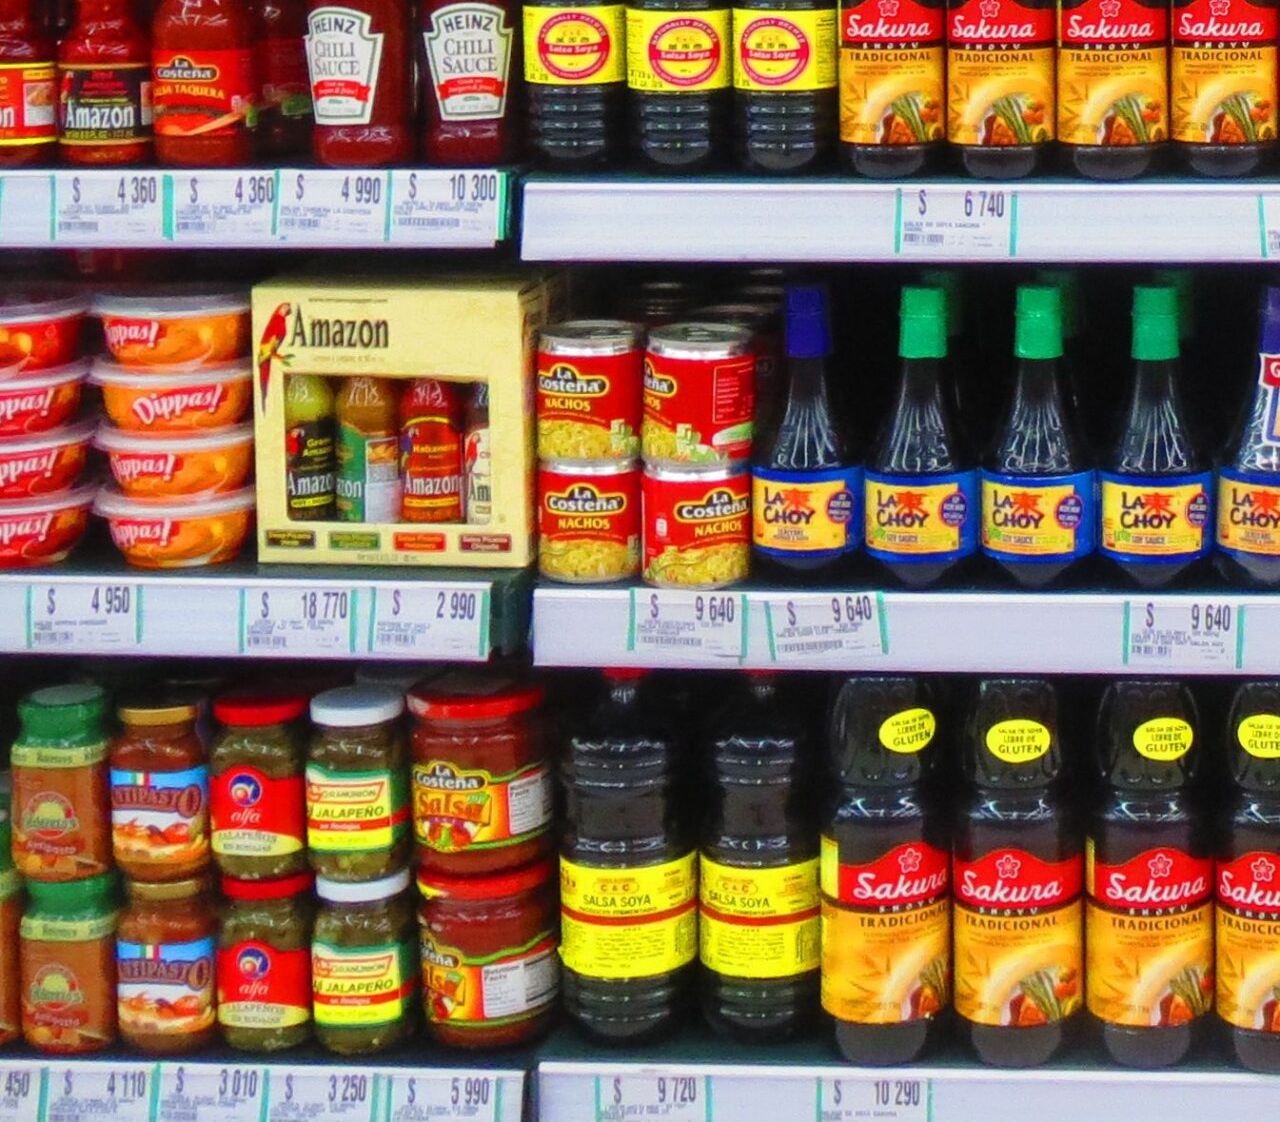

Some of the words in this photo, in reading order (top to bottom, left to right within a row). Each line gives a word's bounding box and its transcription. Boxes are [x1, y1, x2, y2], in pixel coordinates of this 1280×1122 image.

[313, 17, 356, 35] HEINZ
[443, 15, 494, 34] HEINZ
[847, 15, 933, 39] Sakura
[952, 16, 1035, 40] Sakura
[1067, 15, 1154, 39] Sakura
[1179, 14, 1264, 37] Sakura
[315, 40, 356, 58] CHILI
[444, 39, 493, 58] CHILI
[850, 52, 931, 62] TRADICIONAL
[1070, 51, 1152, 62] TRADICIONAL
[314, 58, 360, 77] SAUCE
[442, 56, 497, 74] SAUCE
[66, 105, 134, 130] Amazon
[288, 303, 390, 350] Amazon
[556, 366, 571, 379] La
[133, 385, 223, 424] Dippas!
[546, 397, 591, 412] NACHOS
[404, 475, 462, 495] Amazon
[575, 487, 592, 499] La
[549, 495, 619, 511] Costeña
[764, 487, 783, 507] LA
[993, 490, 1014, 510] LA
[558, 517, 611, 530] NACHOS
[763, 506, 816, 525] CHOY
[992, 508, 1045, 529] CHOY
[998, 744, 1042, 755] GLUTEN
[853, 871, 946, 899] Sakura
[962, 873, 1062, 901] Sakura
[1106, 875, 1205, 900] Sakura
[583, 896, 617, 907] SALSA
[621, 895, 651, 906] SOYA
[965, 915, 1057, 931] TRADICIONAL
